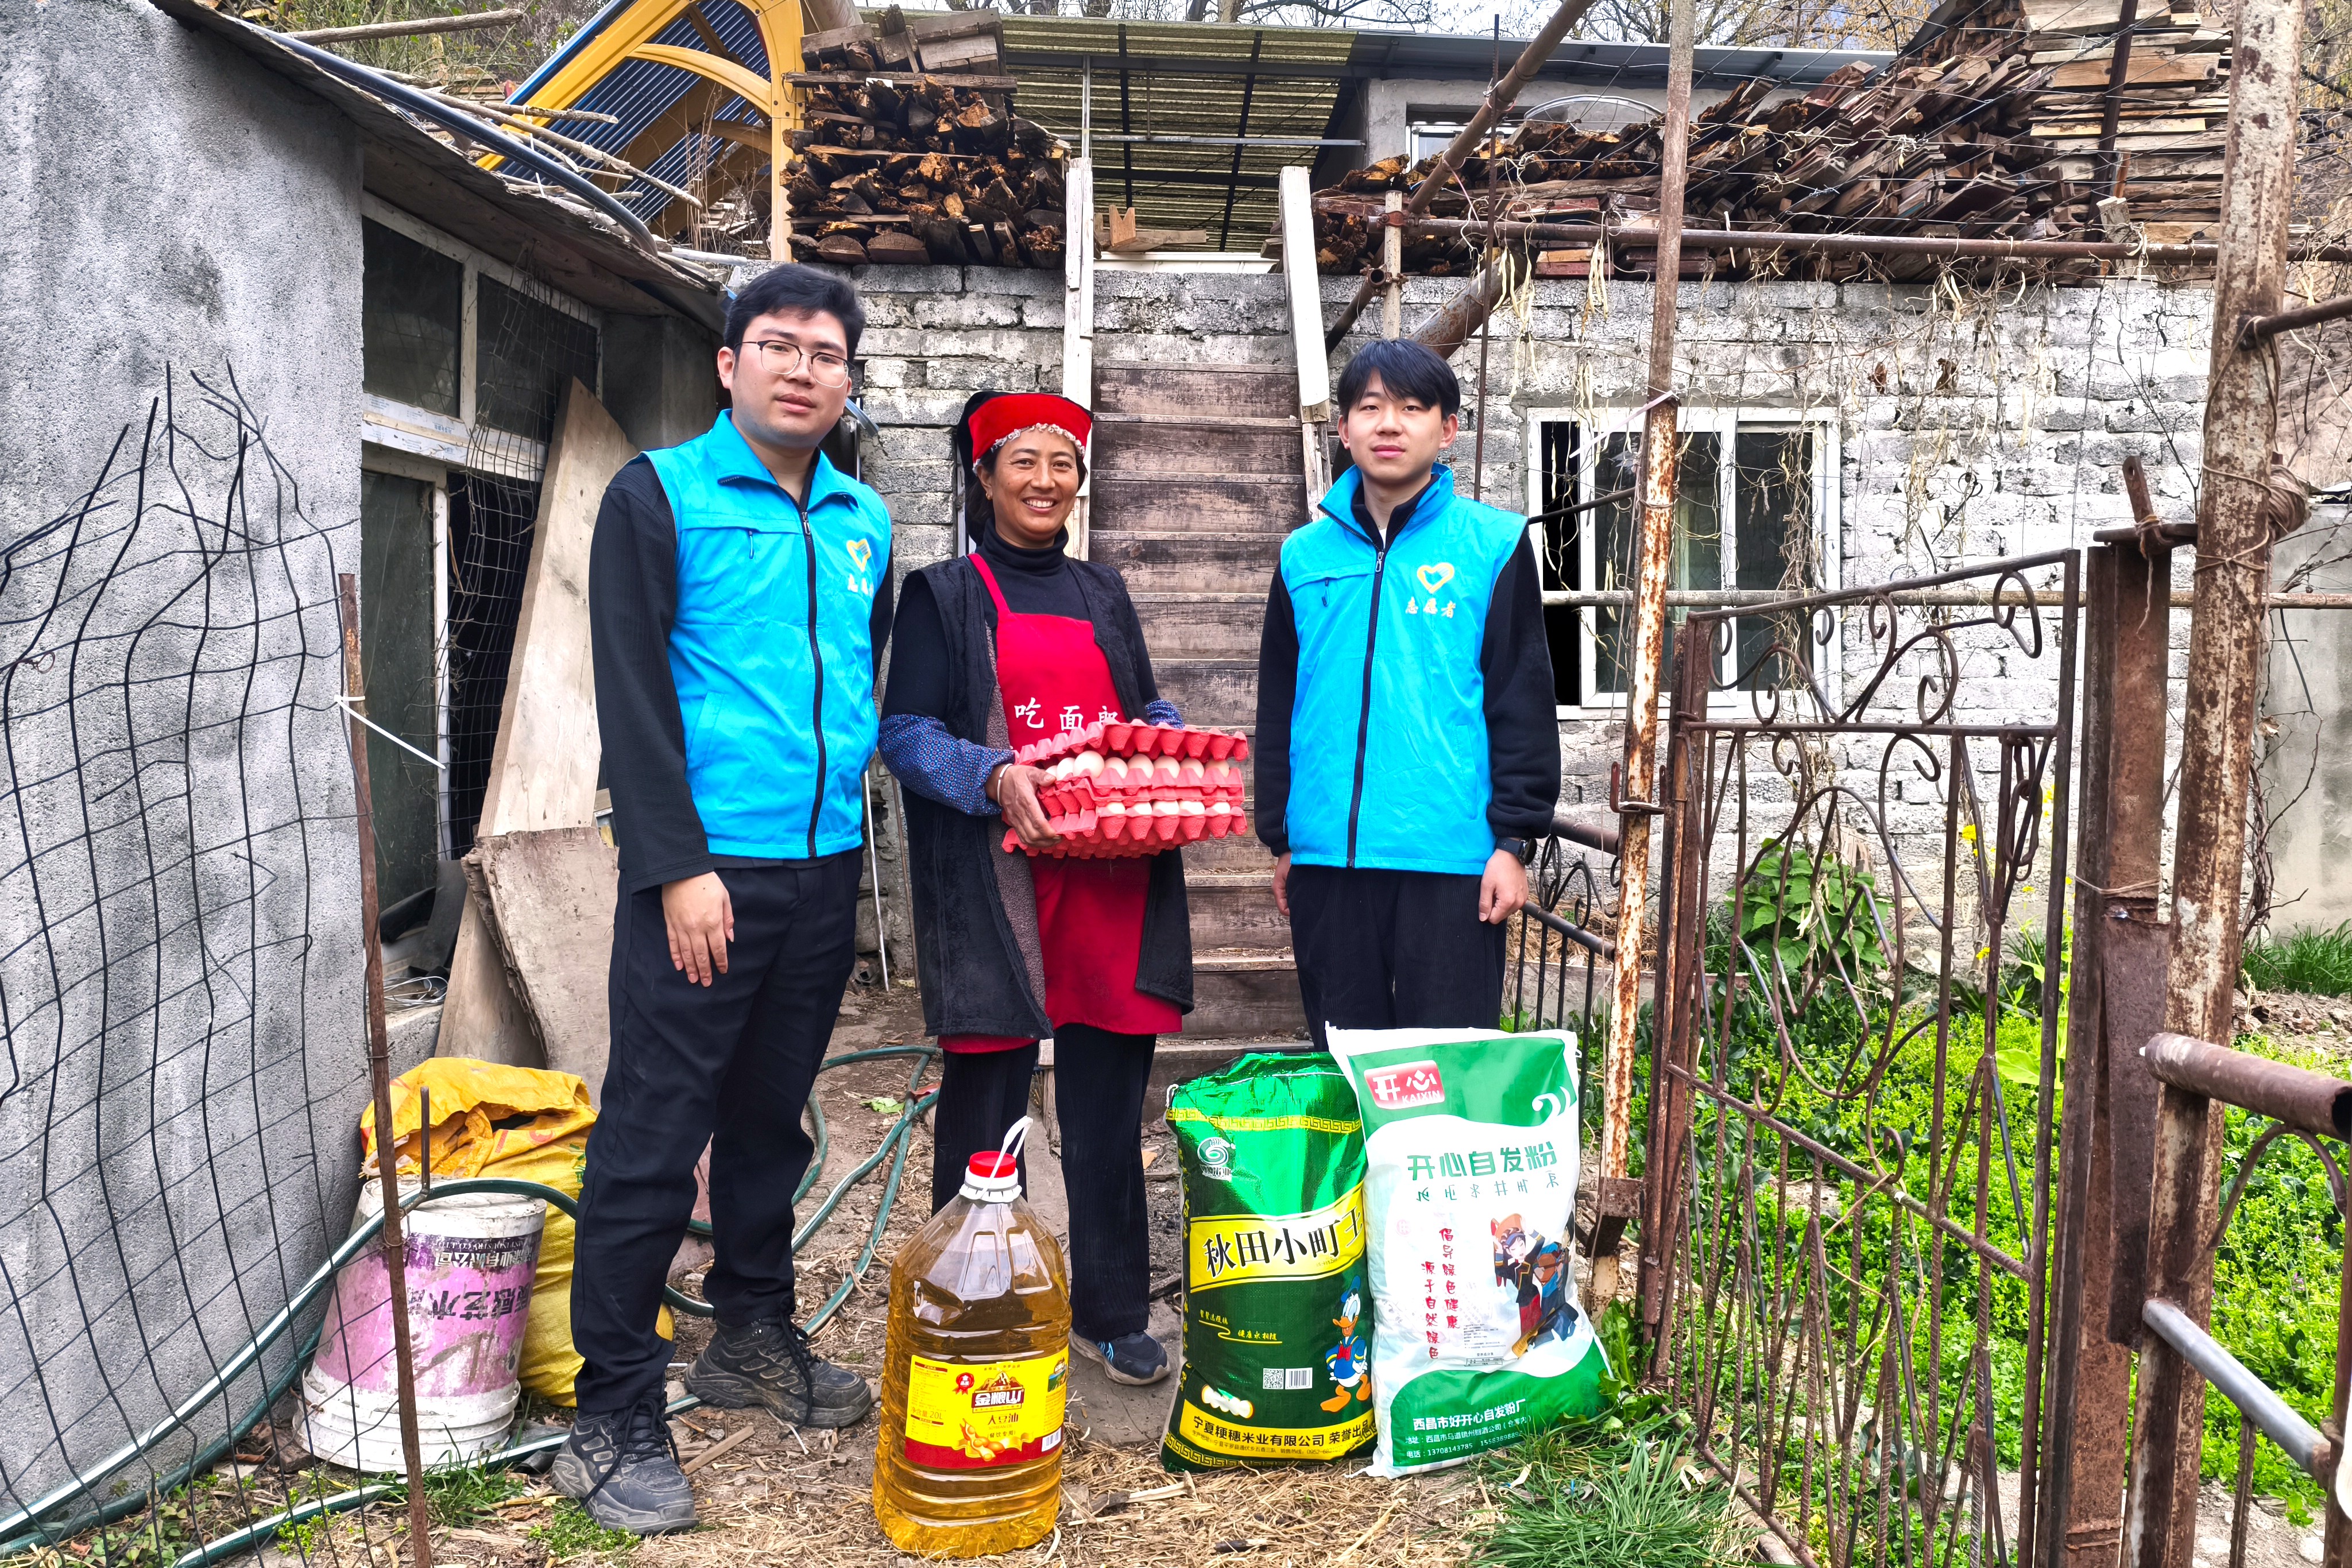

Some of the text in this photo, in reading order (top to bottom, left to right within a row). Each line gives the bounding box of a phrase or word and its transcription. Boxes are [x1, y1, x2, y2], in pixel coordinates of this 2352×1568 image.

[1372, 1069, 1437, 1101] 开心
[1402, 1090, 1441, 1105] KAIXIN
[1407, 1141, 1557, 1180] 开心自发粉
[1202, 1206, 1363, 1277] 秋田小町王
[1439, 1228, 1460, 1329] 倡导绿色健康
[974, 1390, 1022, 1407] 金粮山
[988, 1412, 1019, 1425] 大豆油
[1413, 1399, 1526, 1431] 西昌市好开心自发粉厂
[1329, 1419, 1369, 1444] 荣誉出品
